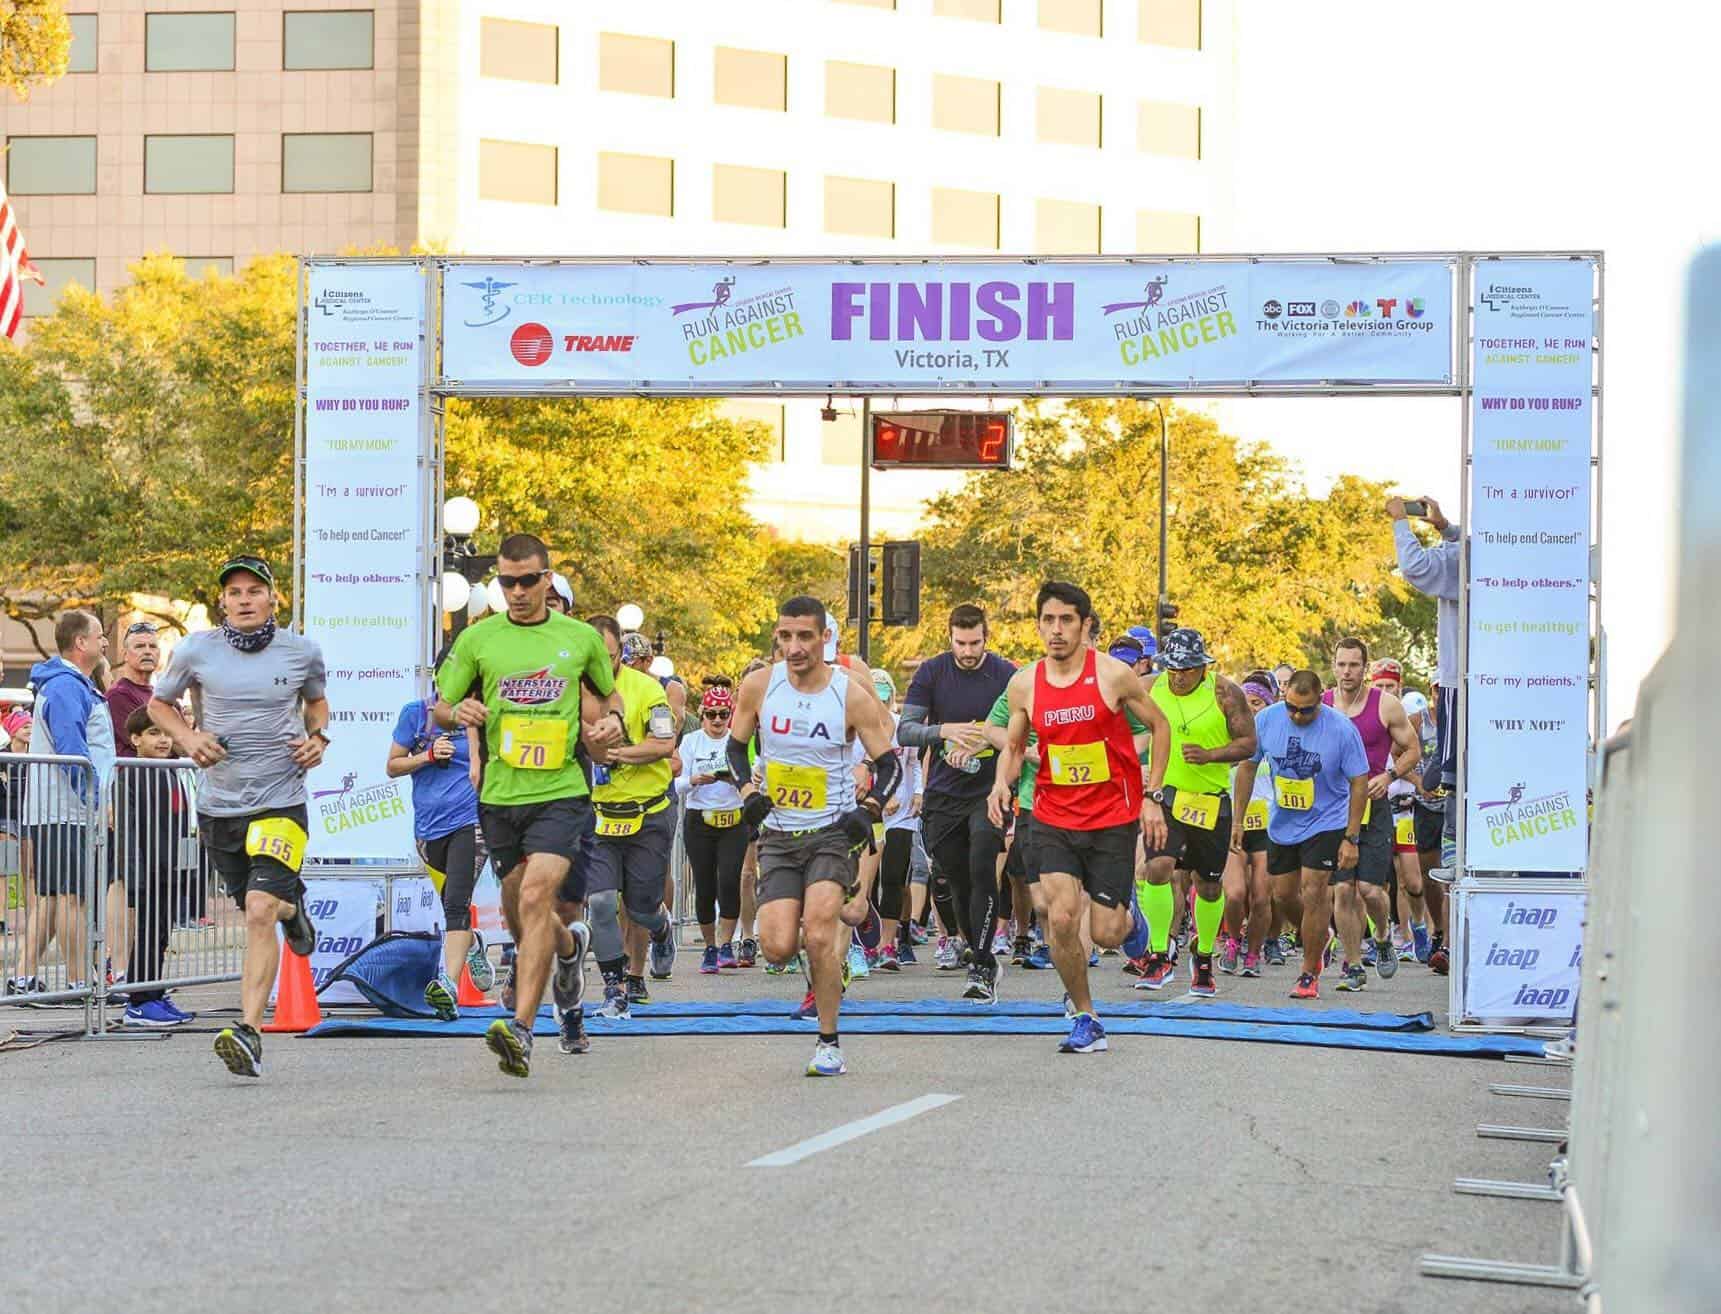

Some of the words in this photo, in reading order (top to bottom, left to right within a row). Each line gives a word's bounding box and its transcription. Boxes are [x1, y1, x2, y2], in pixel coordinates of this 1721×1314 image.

[514, 293, 552, 304] CER
[561, 293, 664, 307] Technology
[682, 316, 720, 341] RUN
[725, 293, 796, 328] AGAINST
[831, 281, 1075, 342] FINISH
[1113, 315, 1152, 341] RUN
[1157, 291, 1228, 328] AGAINST
[1289, 303, 1315, 315] FOX
[1256, 321, 1278, 331] The
[1281, 320, 1329, 331] Victoria
[1333, 320, 1393, 331] Television
[1396, 321, 1434, 332] Group
[564, 335, 635, 351] TRANE
[689, 311, 805, 366] CANCER
[1120, 310, 1237, 366] CANCER
[1480, 339, 1539, 350] TOGETHER,
[1544, 339, 1559, 349] WE
[1564, 339, 1585, 349] RUN
[314, 342, 369, 352] TOGETHER,
[374, 342, 388, 351] WE
[393, 342, 413, 351] RUN
[895, 349, 979, 370] Victoria,
[982, 350, 1009, 368] TX
[316, 399, 340, 410] WHY
[342, 399, 356, 410] DO
[359, 399, 379, 410] YOU
[382, 399, 410, 410] RUN?
[1481, 398, 1510, 410] WHY
[1510, 398, 1525, 410] DO
[1528, 398, 1549, 410] YOU
[1552, 398, 1582, 410] RUN?
[983, 425, 1005, 460] 2
[343, 488, 349, 497] a
[1511, 489, 1517, 499] a
[330, 528, 349, 542] help
[352, 529, 369, 541] end
[1496, 531, 1517, 546] help
[1520, 531, 1538, 544] end
[336, 573, 359, 585] help
[1502, 577, 1528, 589] help
[337, 670, 352, 680] my
[1504, 676, 1521, 688] my
[500, 679, 565, 688] INTERSTATE
[501, 689, 560, 697] BATTERIES
[1045, 705, 1095, 727] PERU
[771, 716, 831, 740] USA
[519, 745, 545, 767] 70
[1068, 766, 1092, 783] 32
[320, 800, 346, 816] RUN
[350, 783, 400, 808] AGAINST
[776, 787, 813, 809] 242
[1284, 794, 1306, 808] 101
[324, 797, 406, 834] CANCER
[714, 813, 734, 825] 150
[1182, 807, 1207, 826] 241
[1486, 811, 1514, 828] RUN
[1518, 796, 1570, 819] AGAINST
[602, 823, 632, 834] 138
[1247, 816, 1262, 828] 95
[1491, 808, 1576, 848] CANCER
[259, 837, 293, 861] 155
[1502, 901, 1558, 928] iaap
[1485, 942, 1540, 969] iaap
[1513, 984, 1570, 1009] iaap
